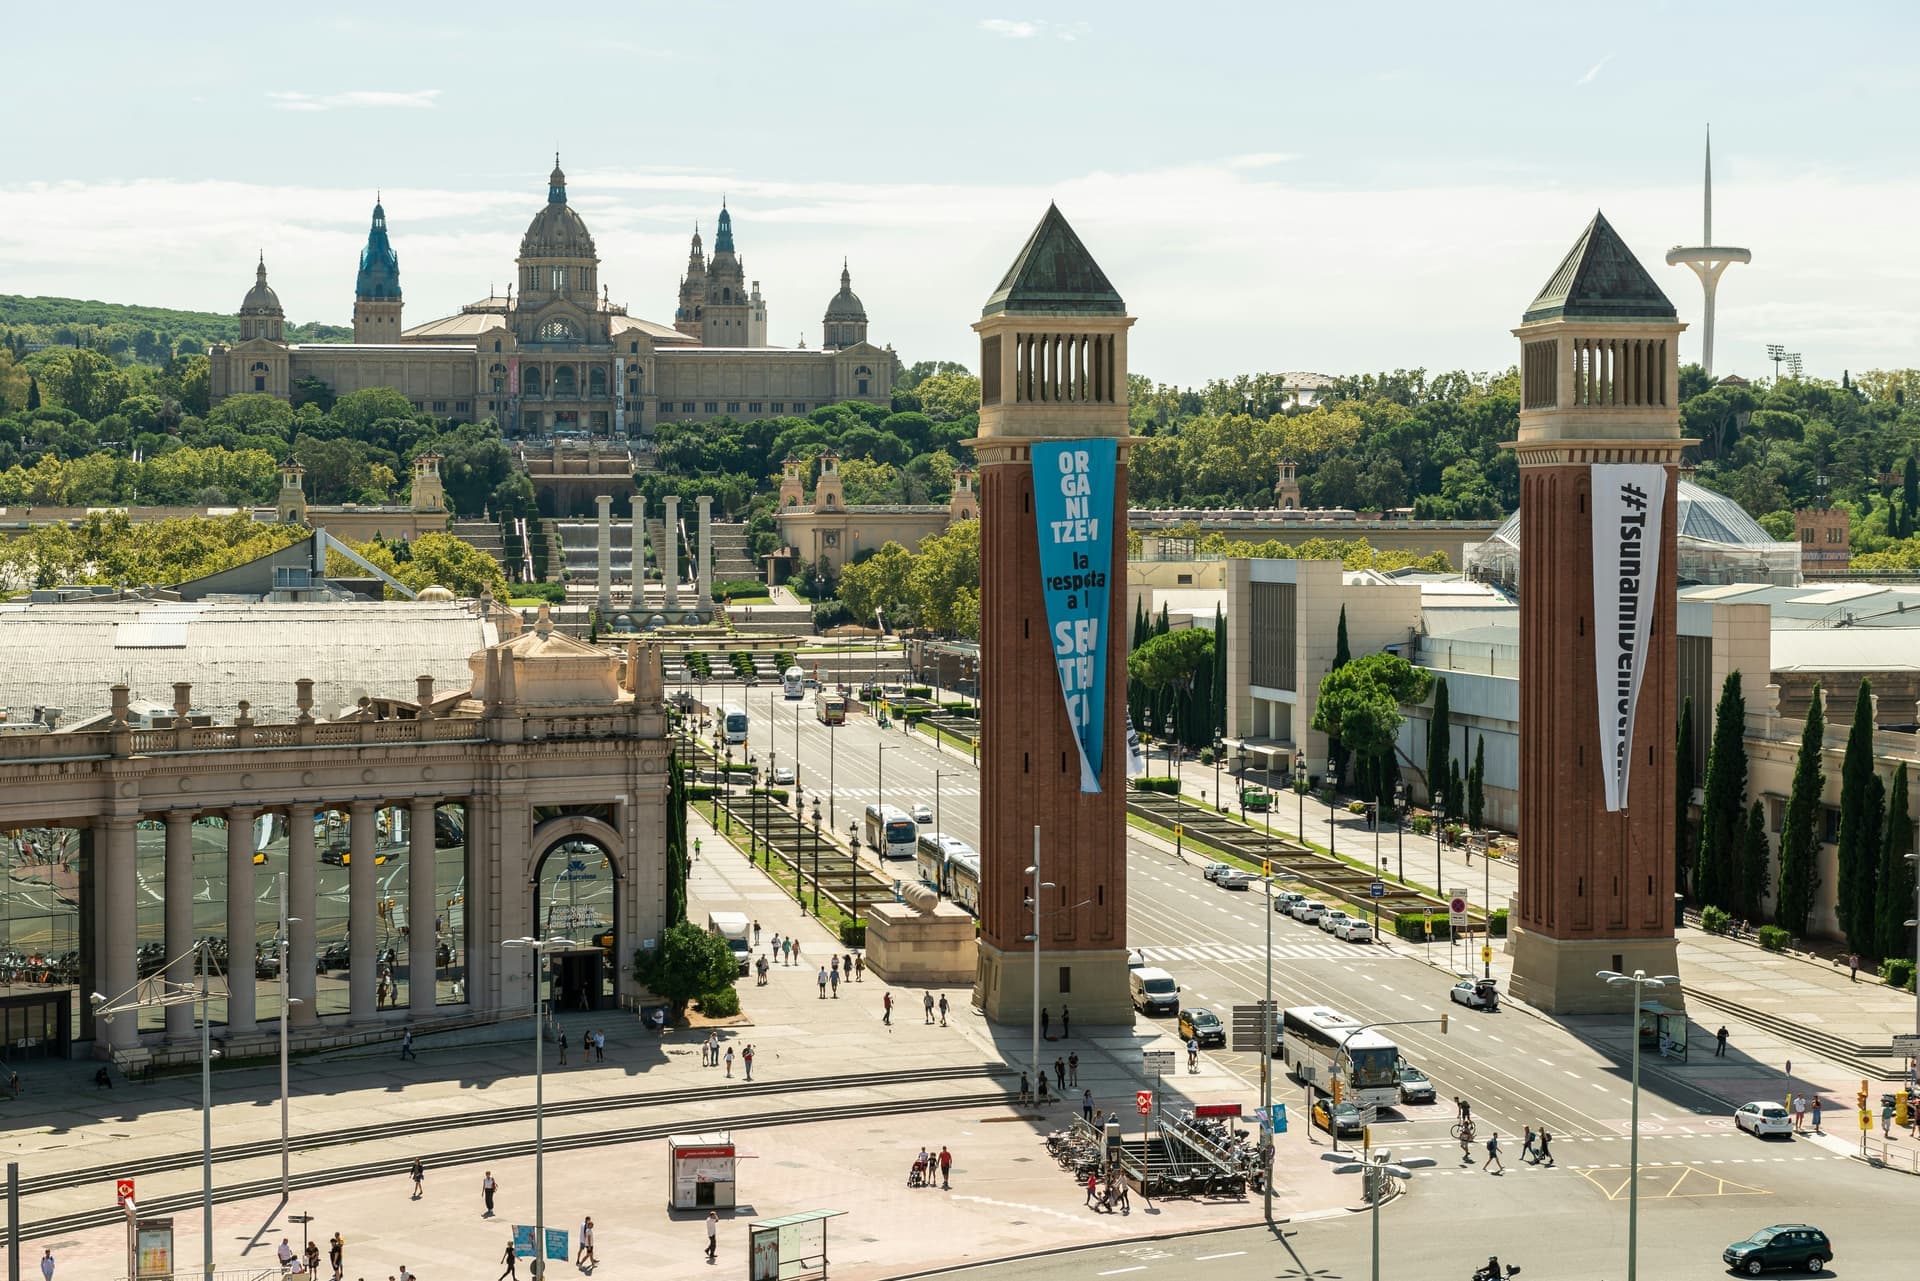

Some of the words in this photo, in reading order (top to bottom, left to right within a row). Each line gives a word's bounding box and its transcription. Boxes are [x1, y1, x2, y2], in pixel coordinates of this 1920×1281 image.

[1058, 450, 1090, 474] OR
[1060, 473, 1091, 497] GA
[1065, 496, 1089, 520] NI
[1073, 551, 1089, 570] la
[1047, 570, 1105, 592] respota
